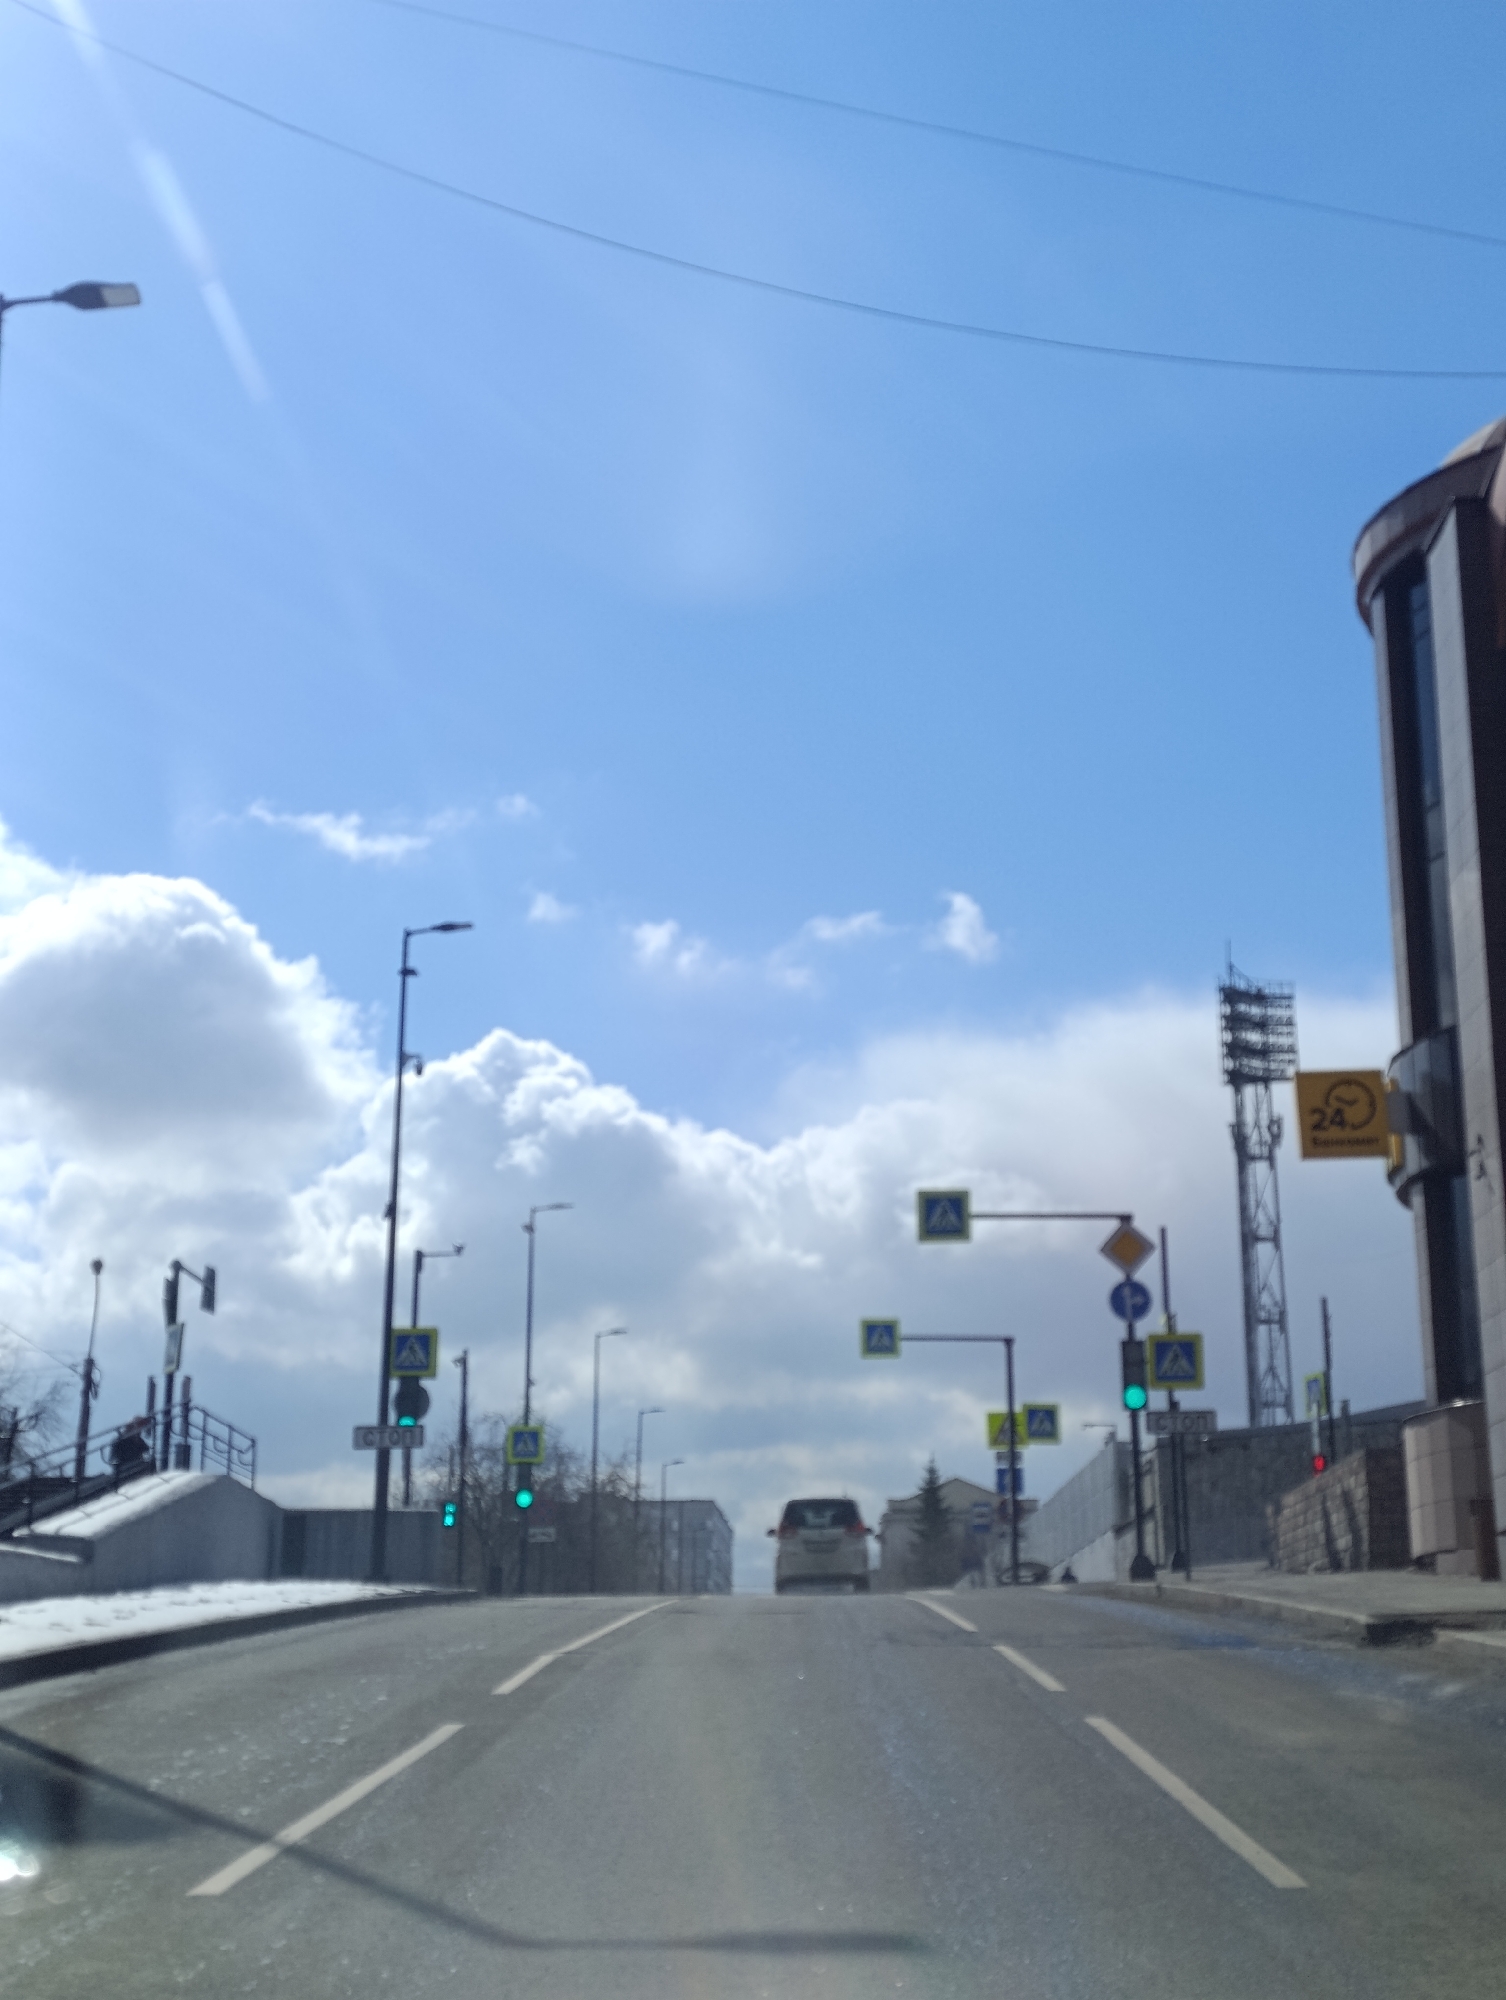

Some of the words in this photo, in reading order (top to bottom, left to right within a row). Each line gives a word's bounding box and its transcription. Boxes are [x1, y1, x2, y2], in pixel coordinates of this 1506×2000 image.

[1311, 1107, 1346, 1131] 24
[1157, 1414, 1208, 1431] СТОП
[362, 1429, 415, 1447] СТОП
